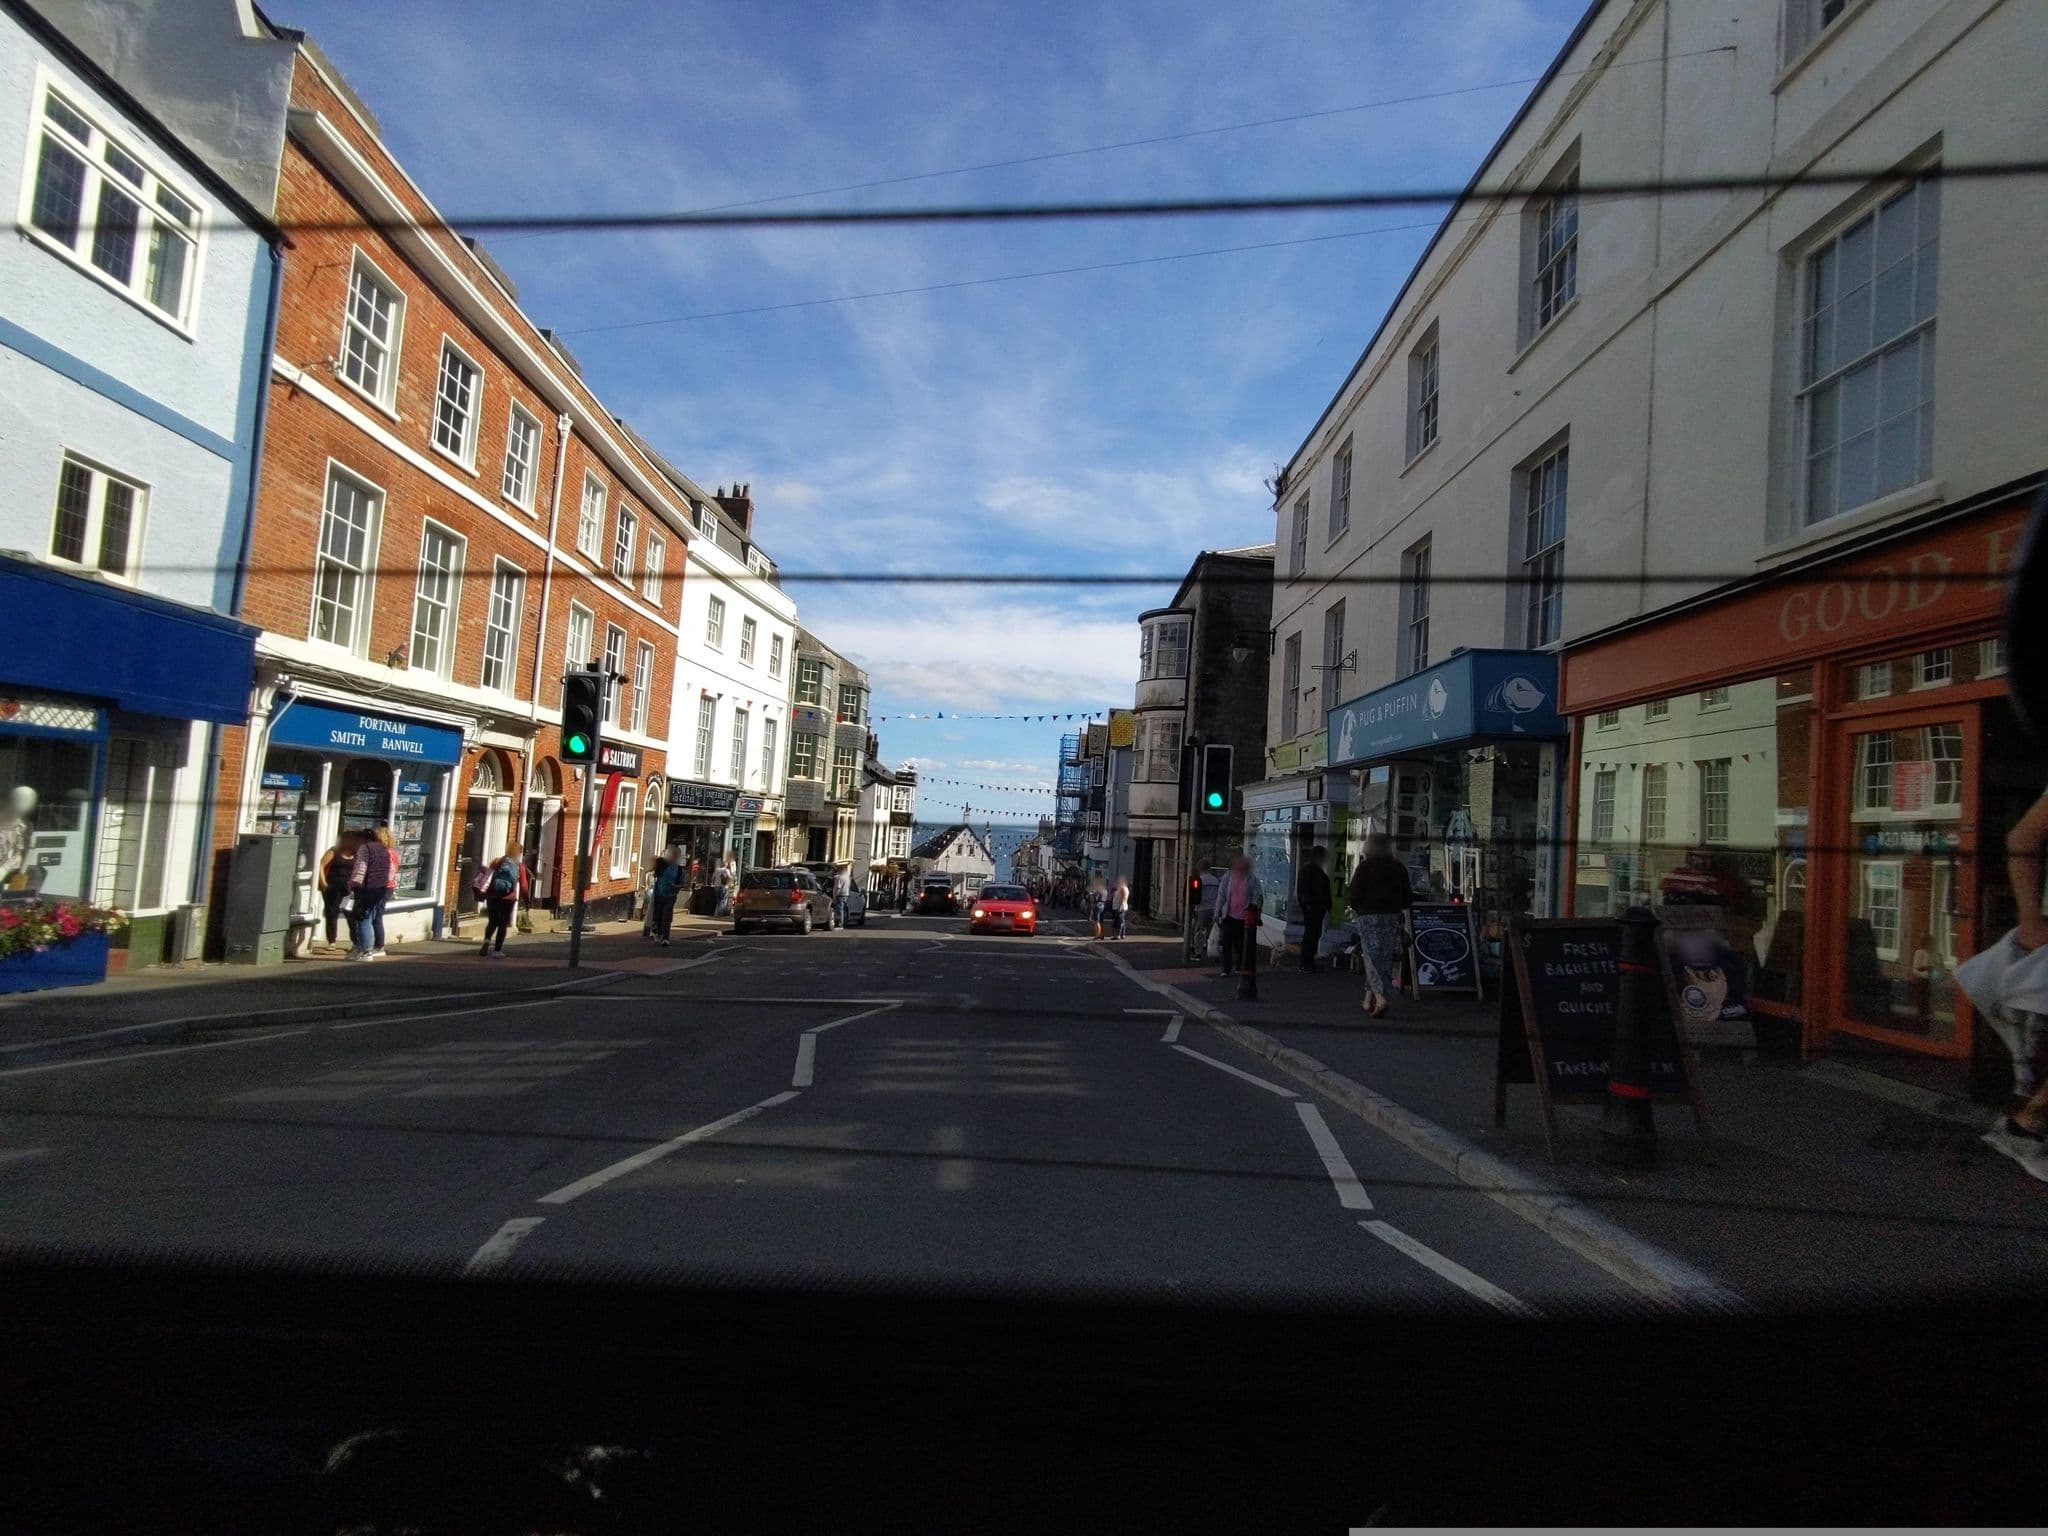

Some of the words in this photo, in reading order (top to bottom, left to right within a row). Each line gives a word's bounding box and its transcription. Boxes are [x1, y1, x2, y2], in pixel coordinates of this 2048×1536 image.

[1779, 552, 1953, 642] GOOD
[1360, 708, 1376, 727] PUG
[1384, 693, 1417, 719] PUFFIN
[359, 715, 407, 736] FORTNAM
[330, 730, 365, 747] SMITH
[381, 737, 424, 754] BANWELL
[609, 750, 637, 769] SALTROCK
[1562, 942, 1610, 956] FRESH
[1581, 981, 1604, 995] AND
